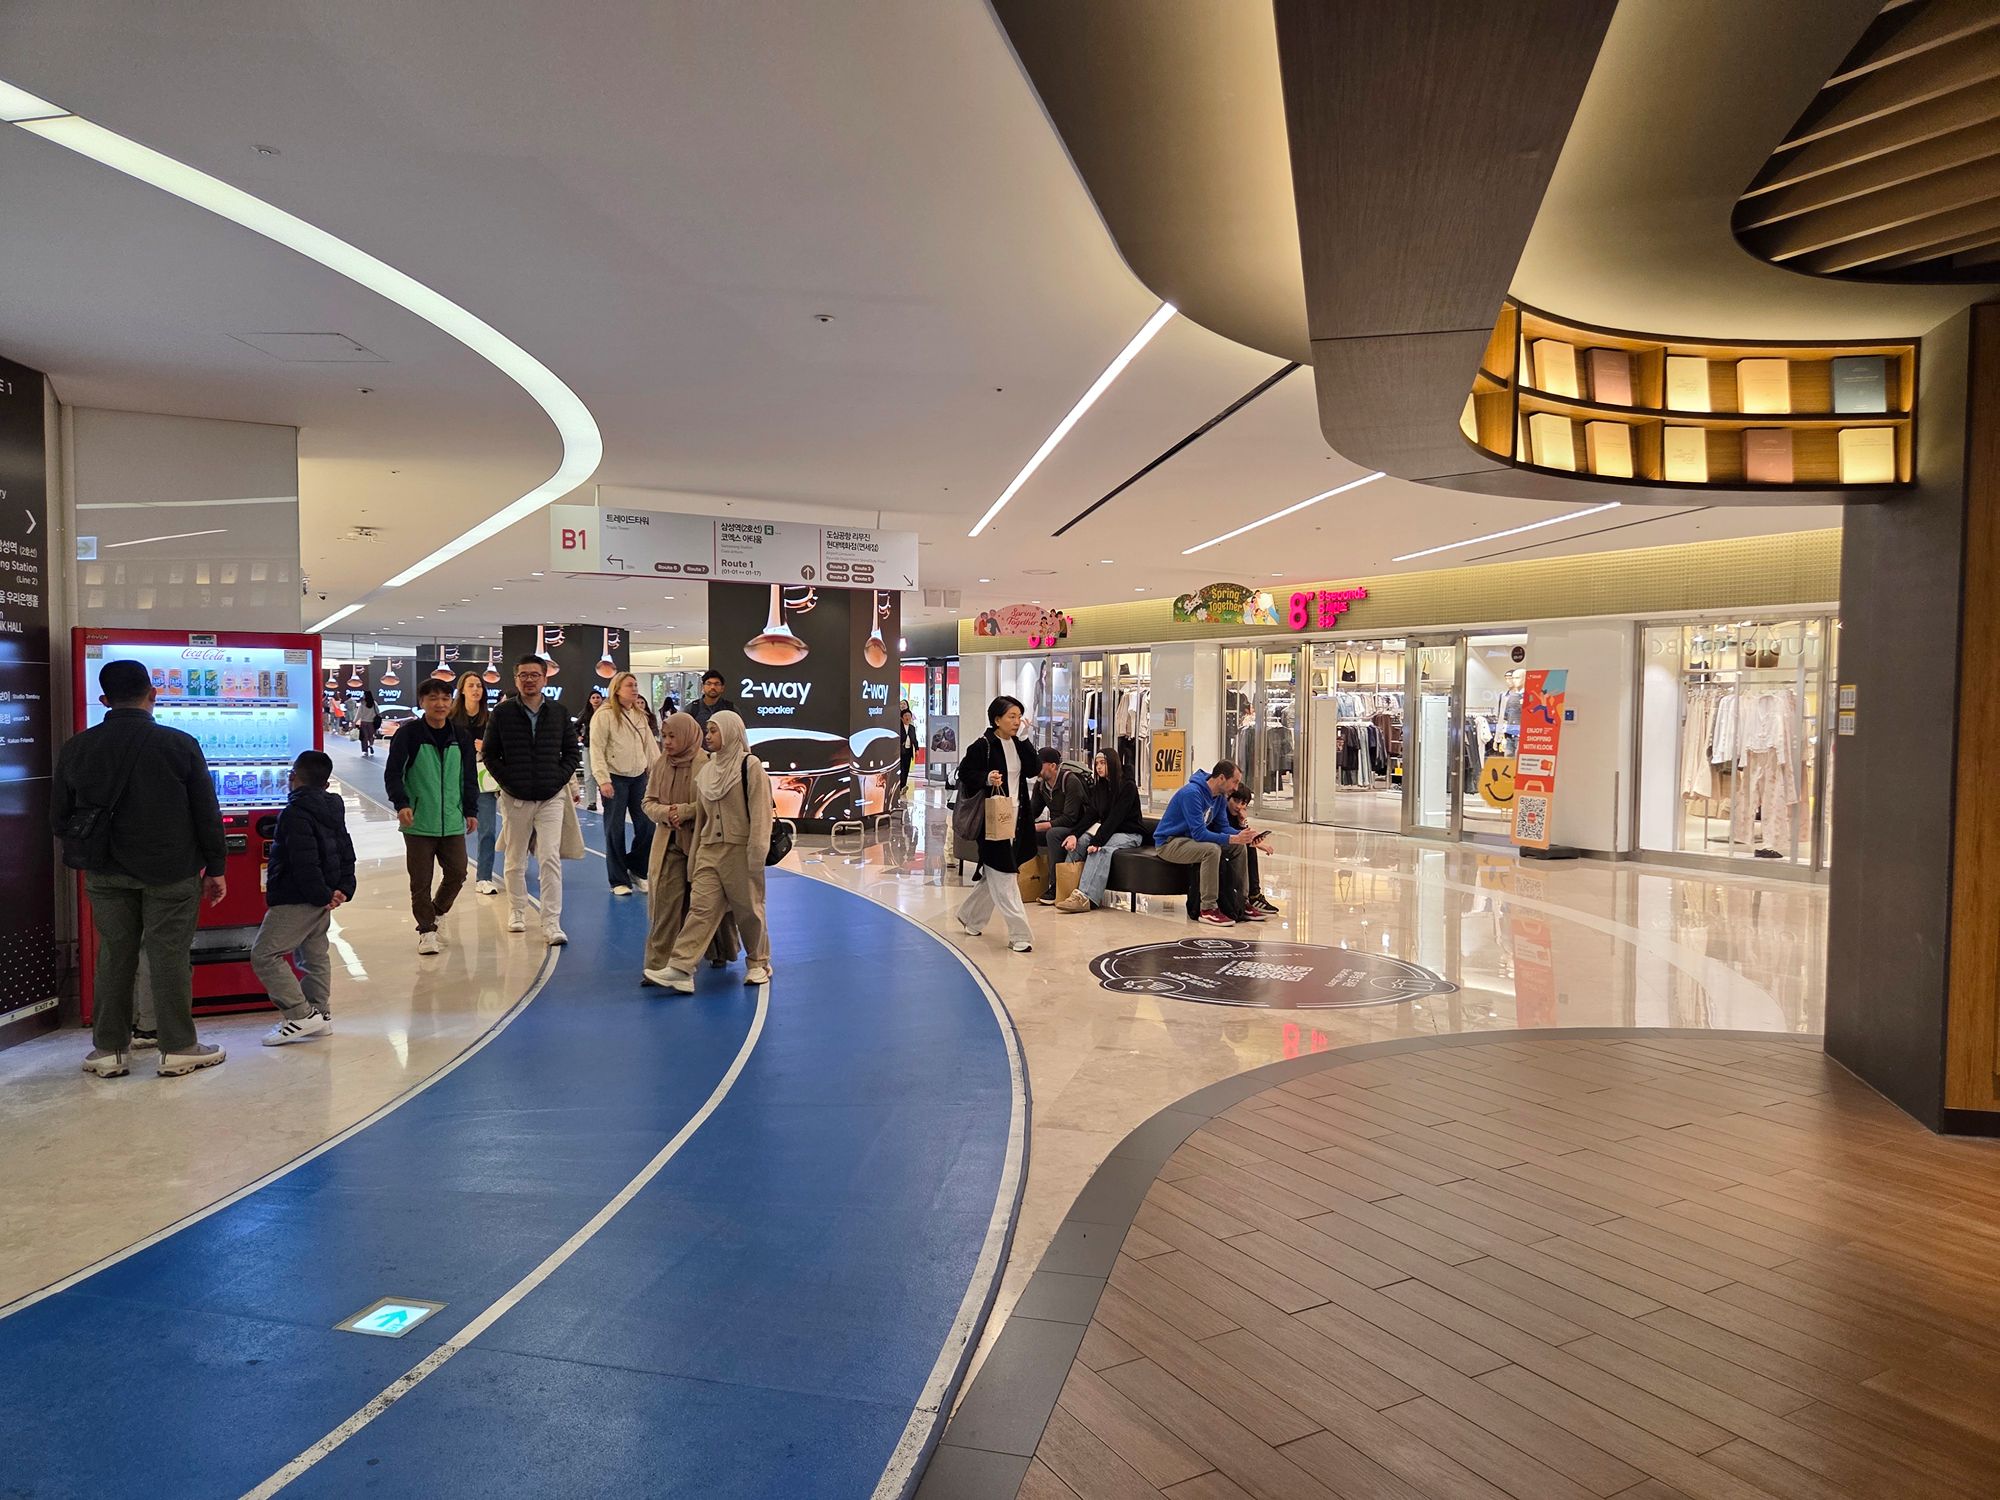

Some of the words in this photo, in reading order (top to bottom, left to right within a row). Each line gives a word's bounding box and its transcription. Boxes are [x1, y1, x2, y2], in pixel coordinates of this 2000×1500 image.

[606, 514, 650, 526] 트레이드타워
[562, 528, 586, 550] B1
[721, 533, 741, 542] 코엑스
[852, 532, 870, 542] 리무진
[0, 540, 17, 554] 성역
[12, 560, 38, 573] Station
[722, 559, 748, 568] Route
[6, 591, 39, 608] 우리은행홀
[1212, 588, 1240, 602] Spring
[1208, 600, 1242, 614] Together
[1011, 608, 1036, 619] Spring
[7, 621, 23, 633] HALL
[1006, 617, 1038, 628] Together
[379, 689, 401, 698] 2-way
[740, 678, 812, 704] 2-way
[862, 680, 888, 705] 2-way
[757, 706, 795, 716] speaker
[35, 1003, 48, 1012] EXIT
